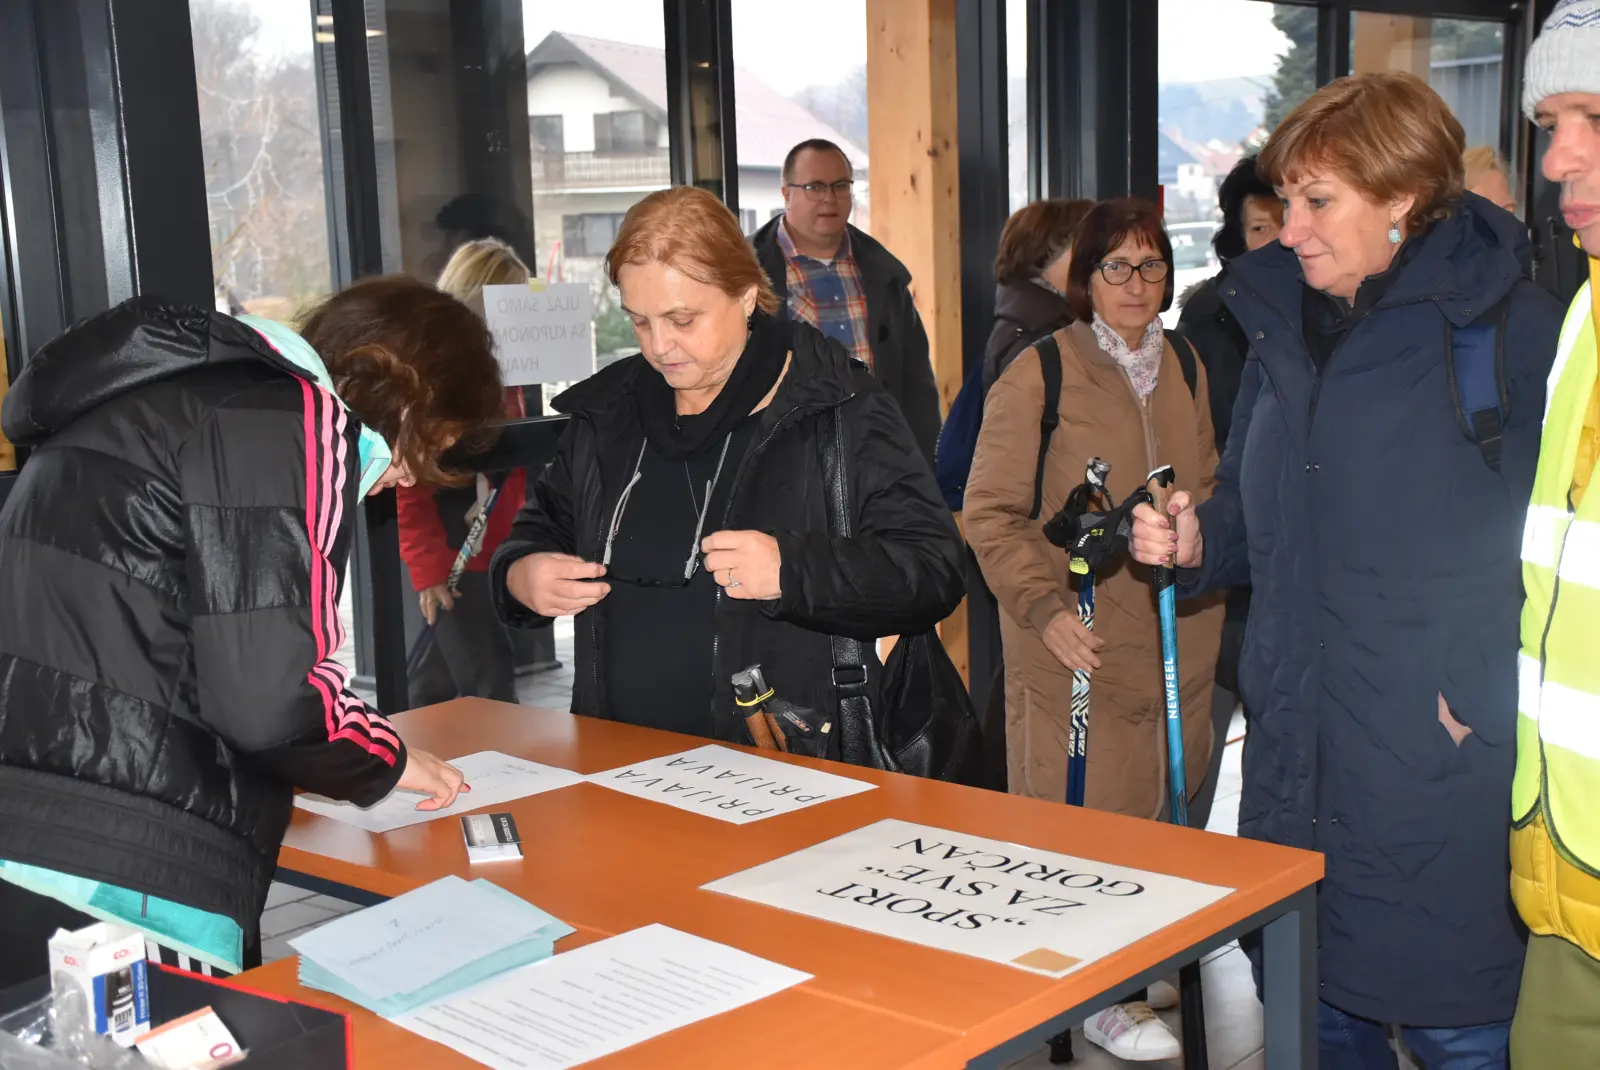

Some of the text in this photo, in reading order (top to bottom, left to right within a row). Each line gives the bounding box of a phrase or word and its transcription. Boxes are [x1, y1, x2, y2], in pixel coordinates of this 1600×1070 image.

[1164, 657, 1178, 719] NEWFEEL
[614, 769, 775, 817] PRIJAVA
[666, 757, 826, 803] PRIJAVA
[893, 837, 1145, 897] GORIČAN
[1007, 889, 1087, 916] ZA
